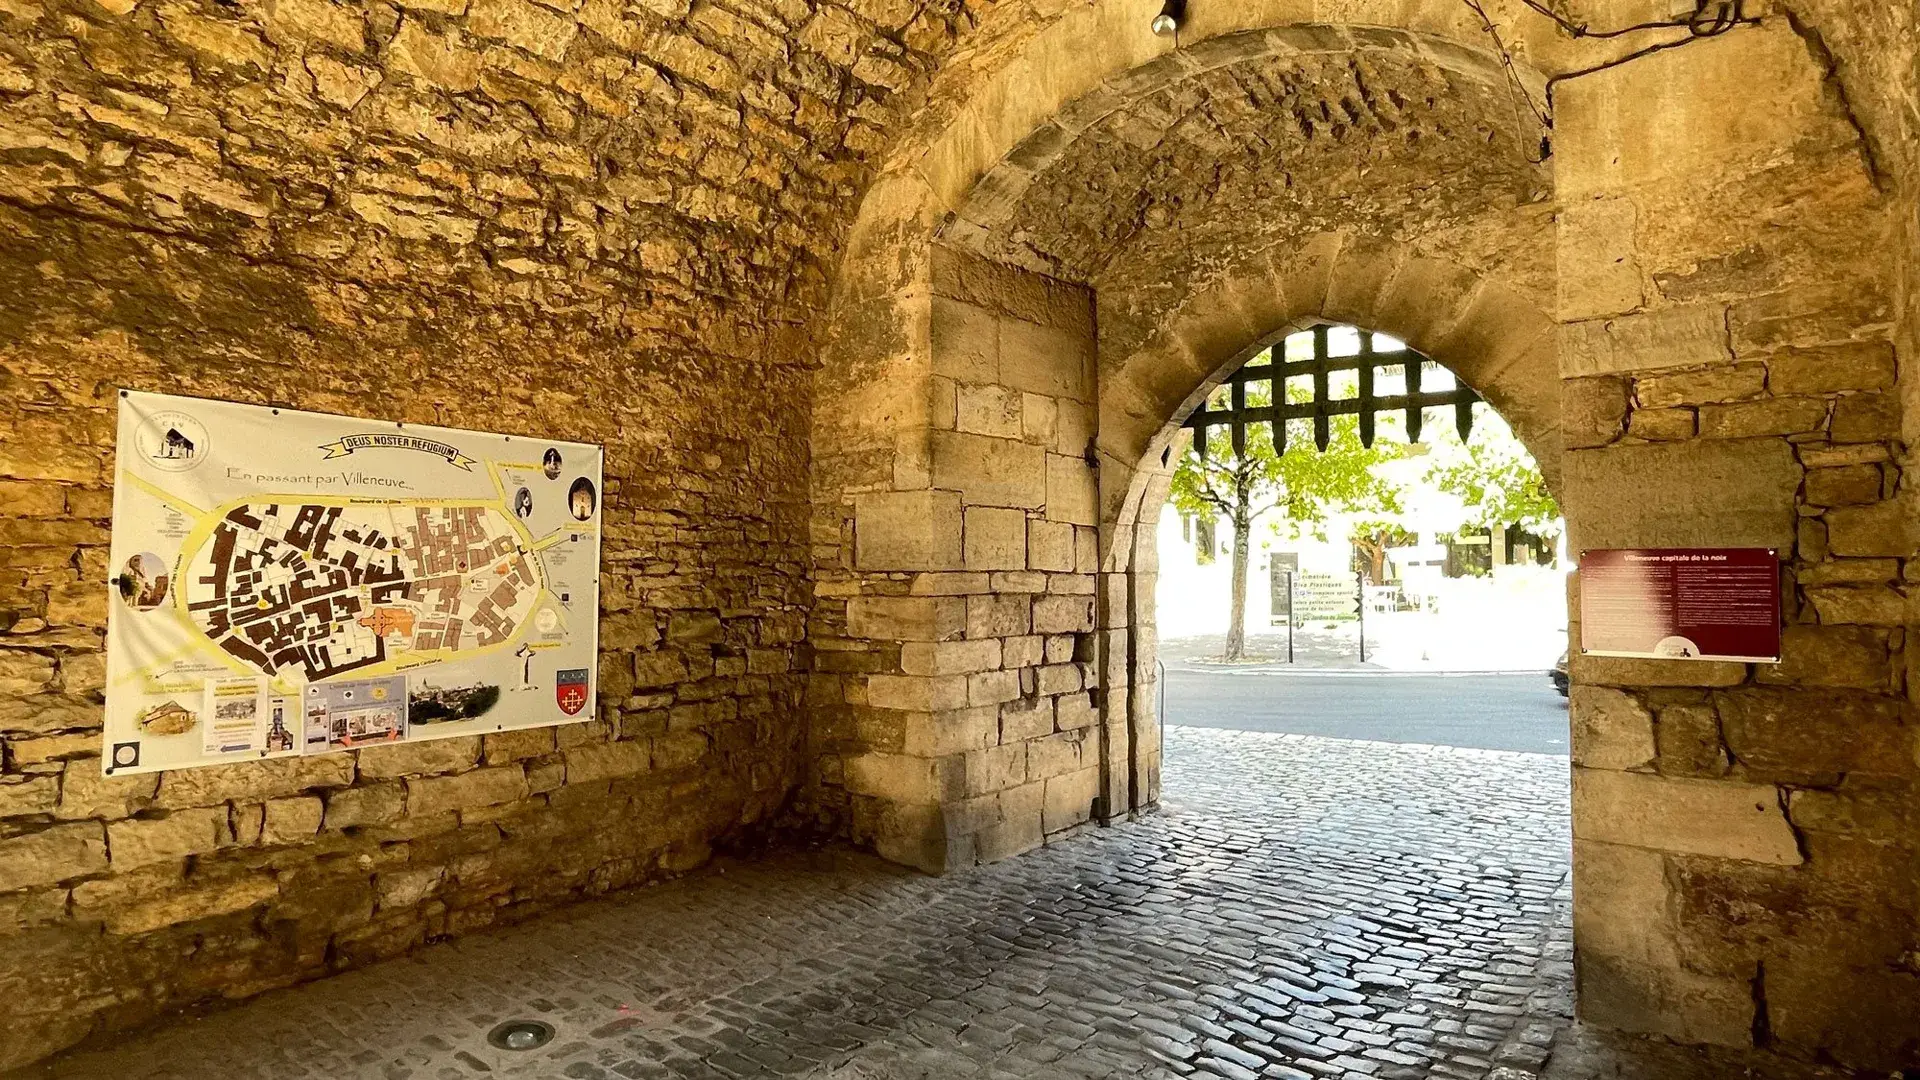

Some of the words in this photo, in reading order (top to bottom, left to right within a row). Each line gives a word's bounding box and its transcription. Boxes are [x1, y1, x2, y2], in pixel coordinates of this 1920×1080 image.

[346, 436, 371, 448] DEUS
[374, 436, 409, 447] NOSTER
[411, 440, 455, 458] REFUGIUM
[226, 467, 252, 480] En
[256, 474, 312, 484] passant
[315, 475, 338, 488] par
